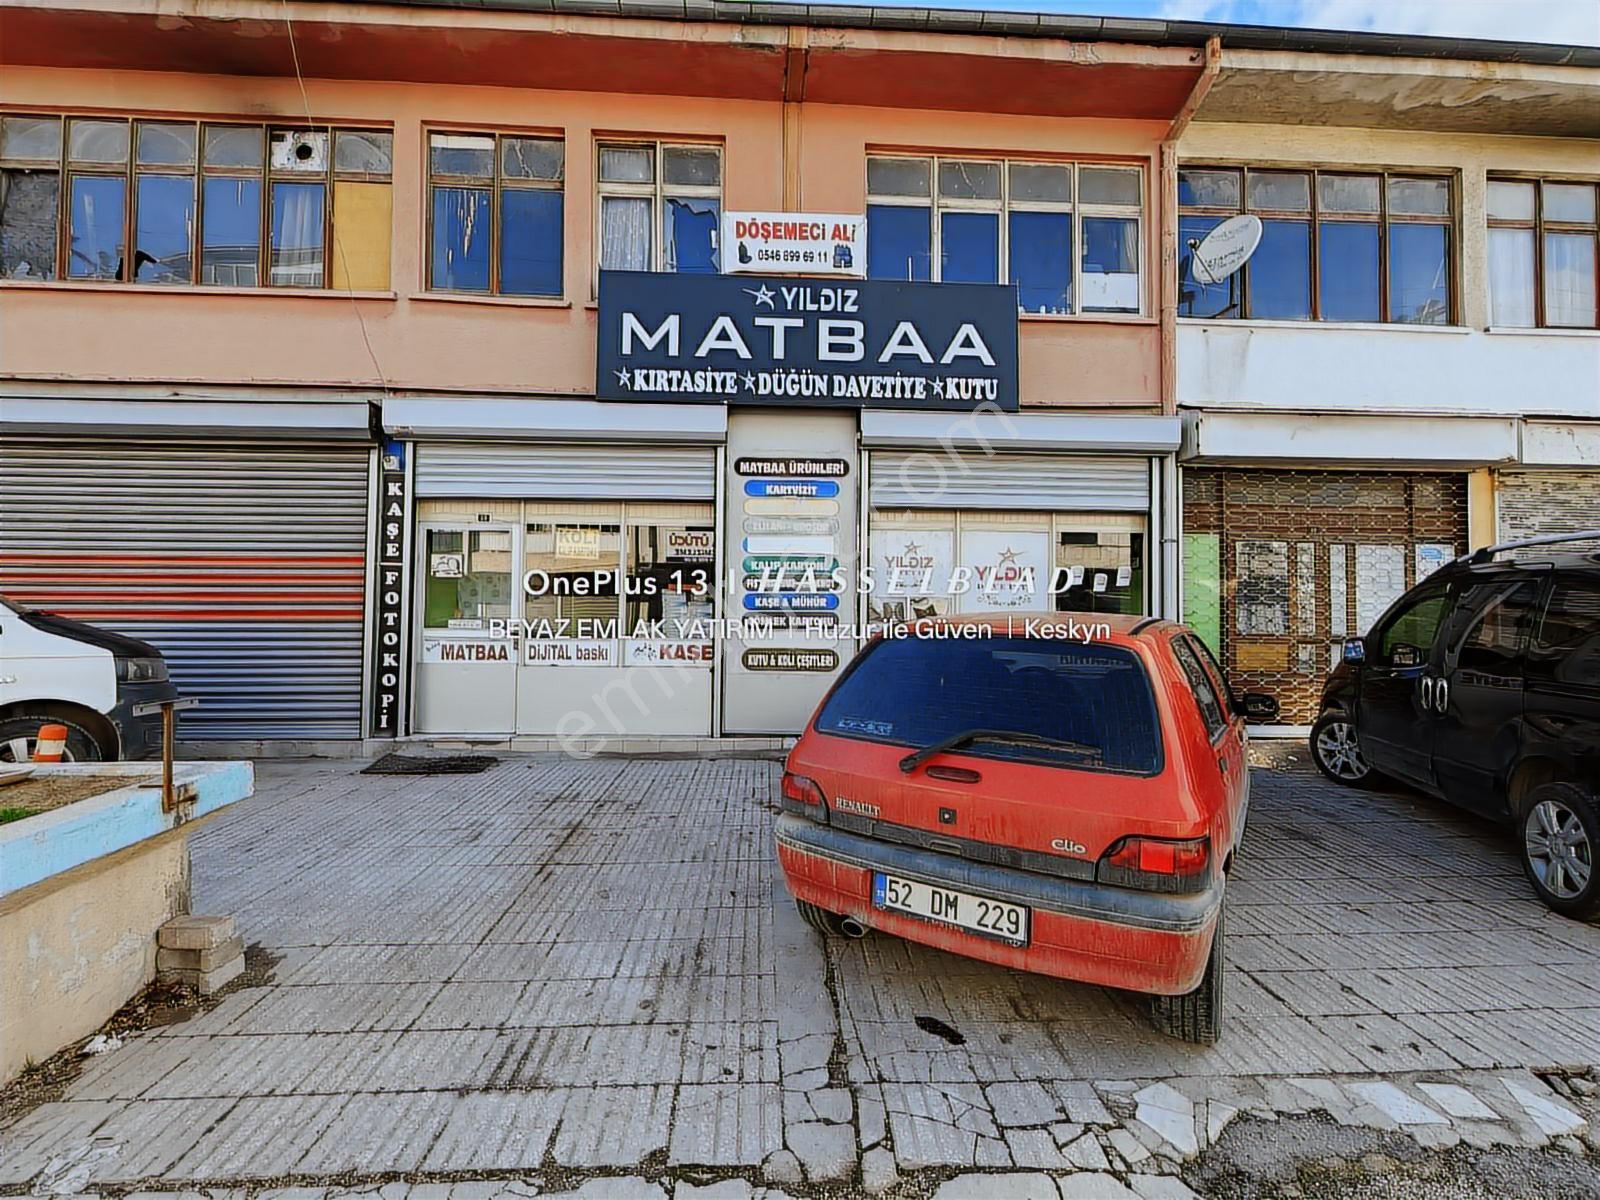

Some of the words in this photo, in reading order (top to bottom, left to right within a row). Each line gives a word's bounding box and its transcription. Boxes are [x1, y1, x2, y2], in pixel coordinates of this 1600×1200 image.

[758, 249, 781, 261] 0546
[783, 250, 801, 262] 899
[803, 250, 815, 262] 69
[818, 251, 828, 263] 11
[781, 286, 860, 312] YILDIZ
[621, 312, 997, 367] MATBAA
[633, 366, 738, 394] KIRTASİYE
[757, 367, 828, 396] DÜĞÜN
[832, 372, 927, 400] DAVETİYE
[945, 378, 998, 400] KUTU
[740, 461, 786, 474] MATBAA
[386, 482, 404, 557] KAŞE
[884, 555, 934, 569] YILDIZ
[441, 644, 509, 661] MATBAA
[836, 797, 880, 816] RENAULT
[1051, 838, 1087, 854] Clio
[887, 878, 913, 908] 52
[930, 889, 959, 921] DM
[976, 901, 1021, 936] 229
